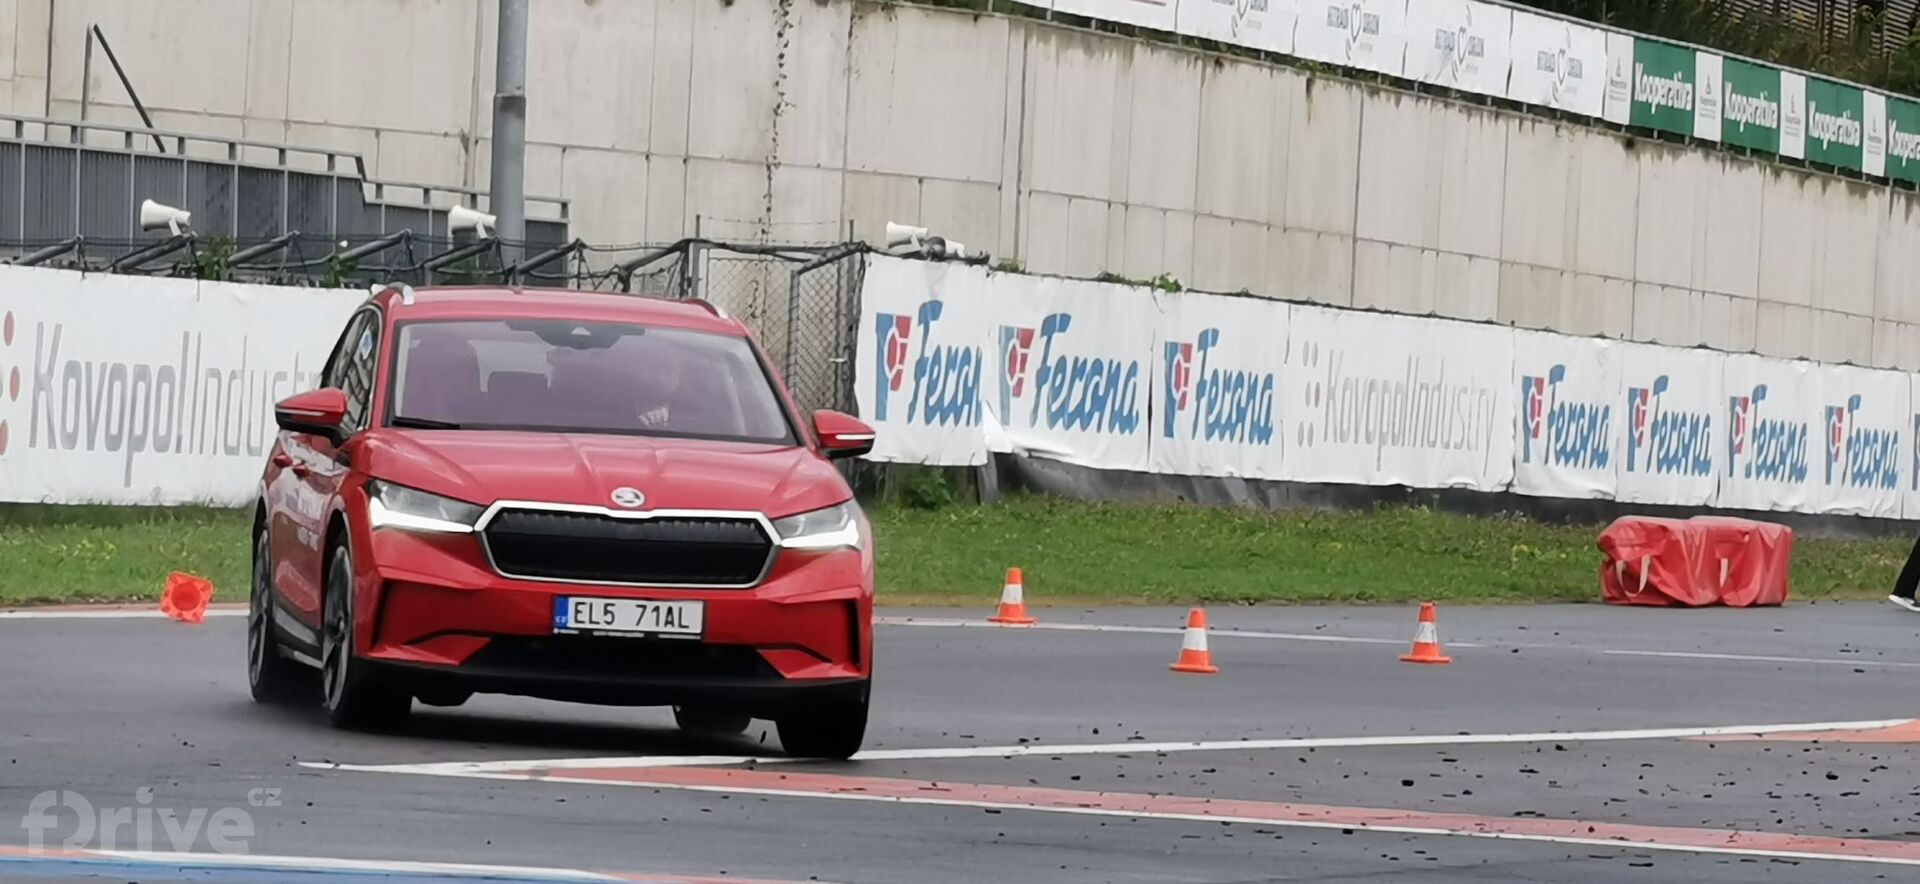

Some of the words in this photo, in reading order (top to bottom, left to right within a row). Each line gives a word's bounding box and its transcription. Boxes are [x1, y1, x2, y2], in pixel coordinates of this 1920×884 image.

[1634, 62, 1692, 114] Kooperativa
[1724, 81, 1777, 132] Kooperativa
[1809, 101, 1860, 150] Kooperativa
[1030, 312, 1140, 435] Ferona
[1191, 327, 1274, 446] Ferona
[1544, 364, 1613, 469] Ferona
[1646, 375, 1711, 474] Ferona
[1745, 384, 1808, 484] Ferona
[1842, 394, 1899, 490] Ferona
[574, 602, 615, 625] EL5
[635, 604, 690, 629] 71AL
